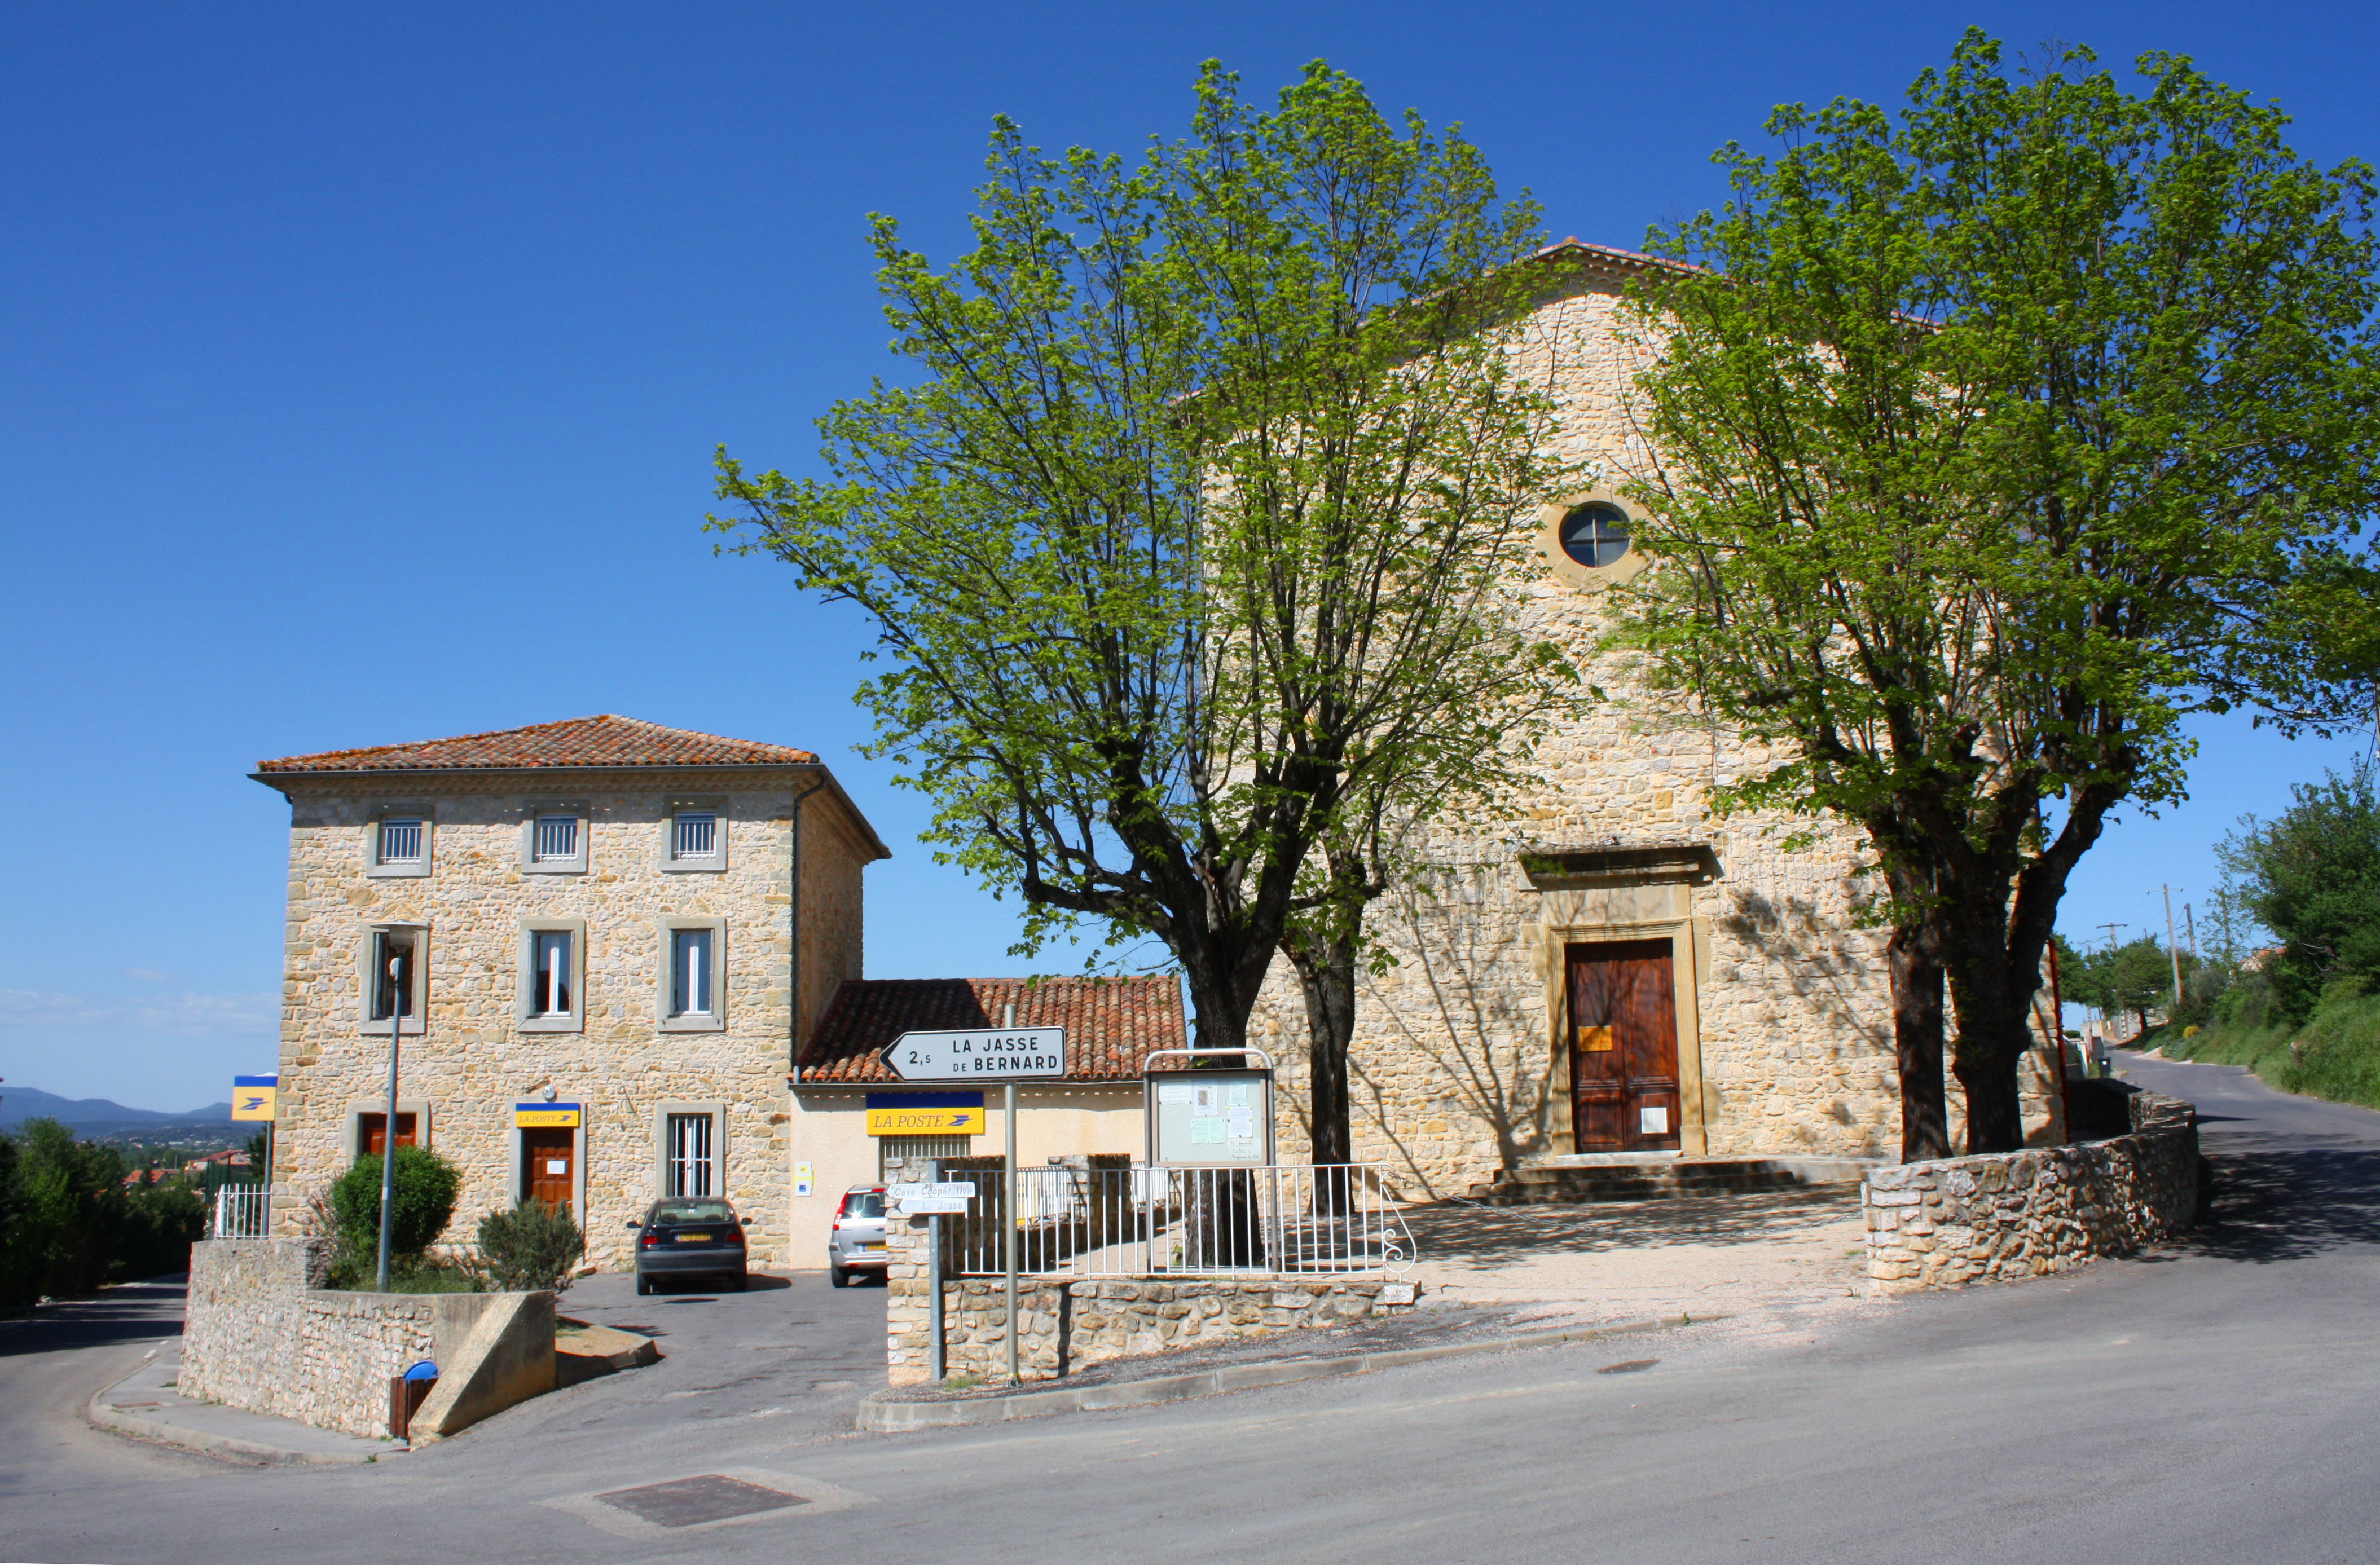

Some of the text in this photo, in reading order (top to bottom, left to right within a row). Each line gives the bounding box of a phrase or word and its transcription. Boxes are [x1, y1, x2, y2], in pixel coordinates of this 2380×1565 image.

[953, 1037, 1038, 1053] LA JASSE
[909, 1051, 931, 1066] 2,5
[953, 1055, 1057, 1072] DE BERNARD
[873, 1116, 944, 1127] LA POSTE
[895, 1187, 916, 1196] Cave
